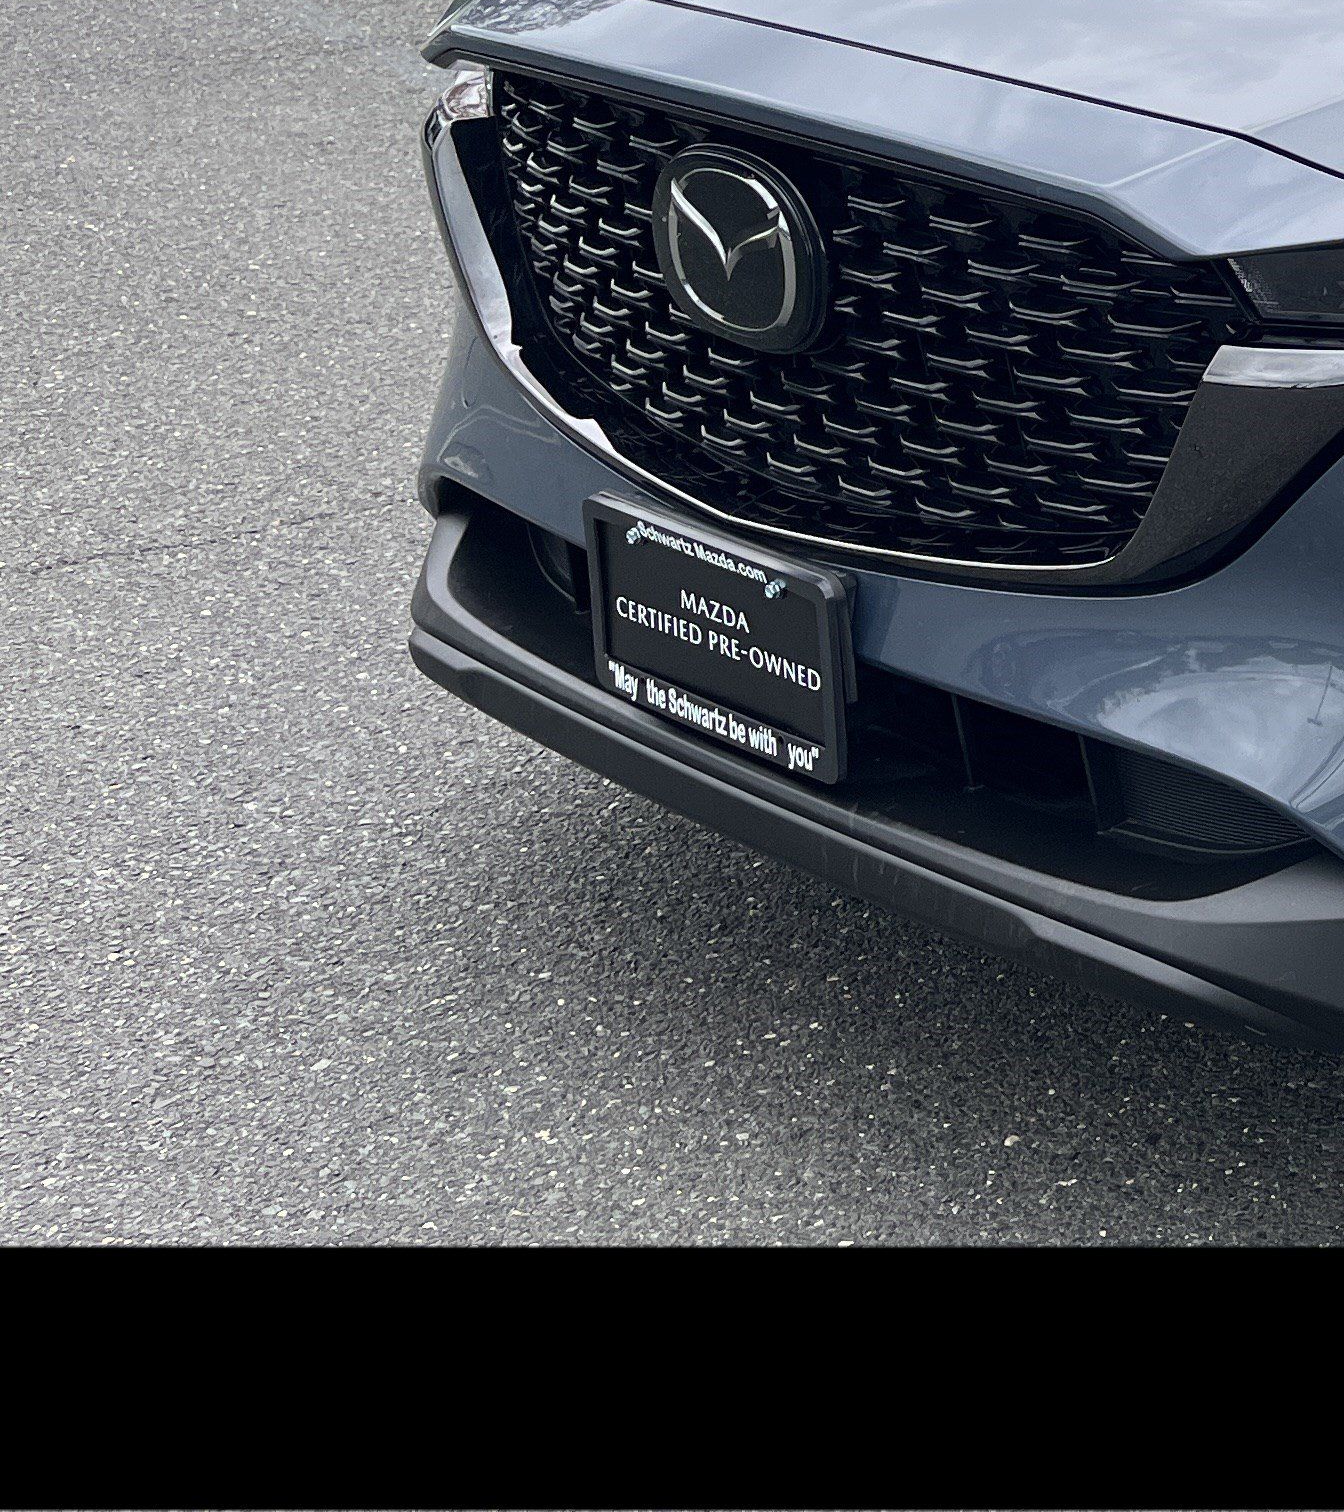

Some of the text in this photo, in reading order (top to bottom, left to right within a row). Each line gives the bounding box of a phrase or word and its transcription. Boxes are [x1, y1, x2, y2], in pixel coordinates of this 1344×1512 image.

[616, 596, 821, 691] CERTIFIED PRE-OWNED
[680, 589, 750, 634] MAZDA
[646, 677, 666, 710] the
[667, 687, 727, 736] Schwartz
[729, 713, 746, 744] be
[749, 725, 777, 757] with
[788, 742, 819, 772] you"
